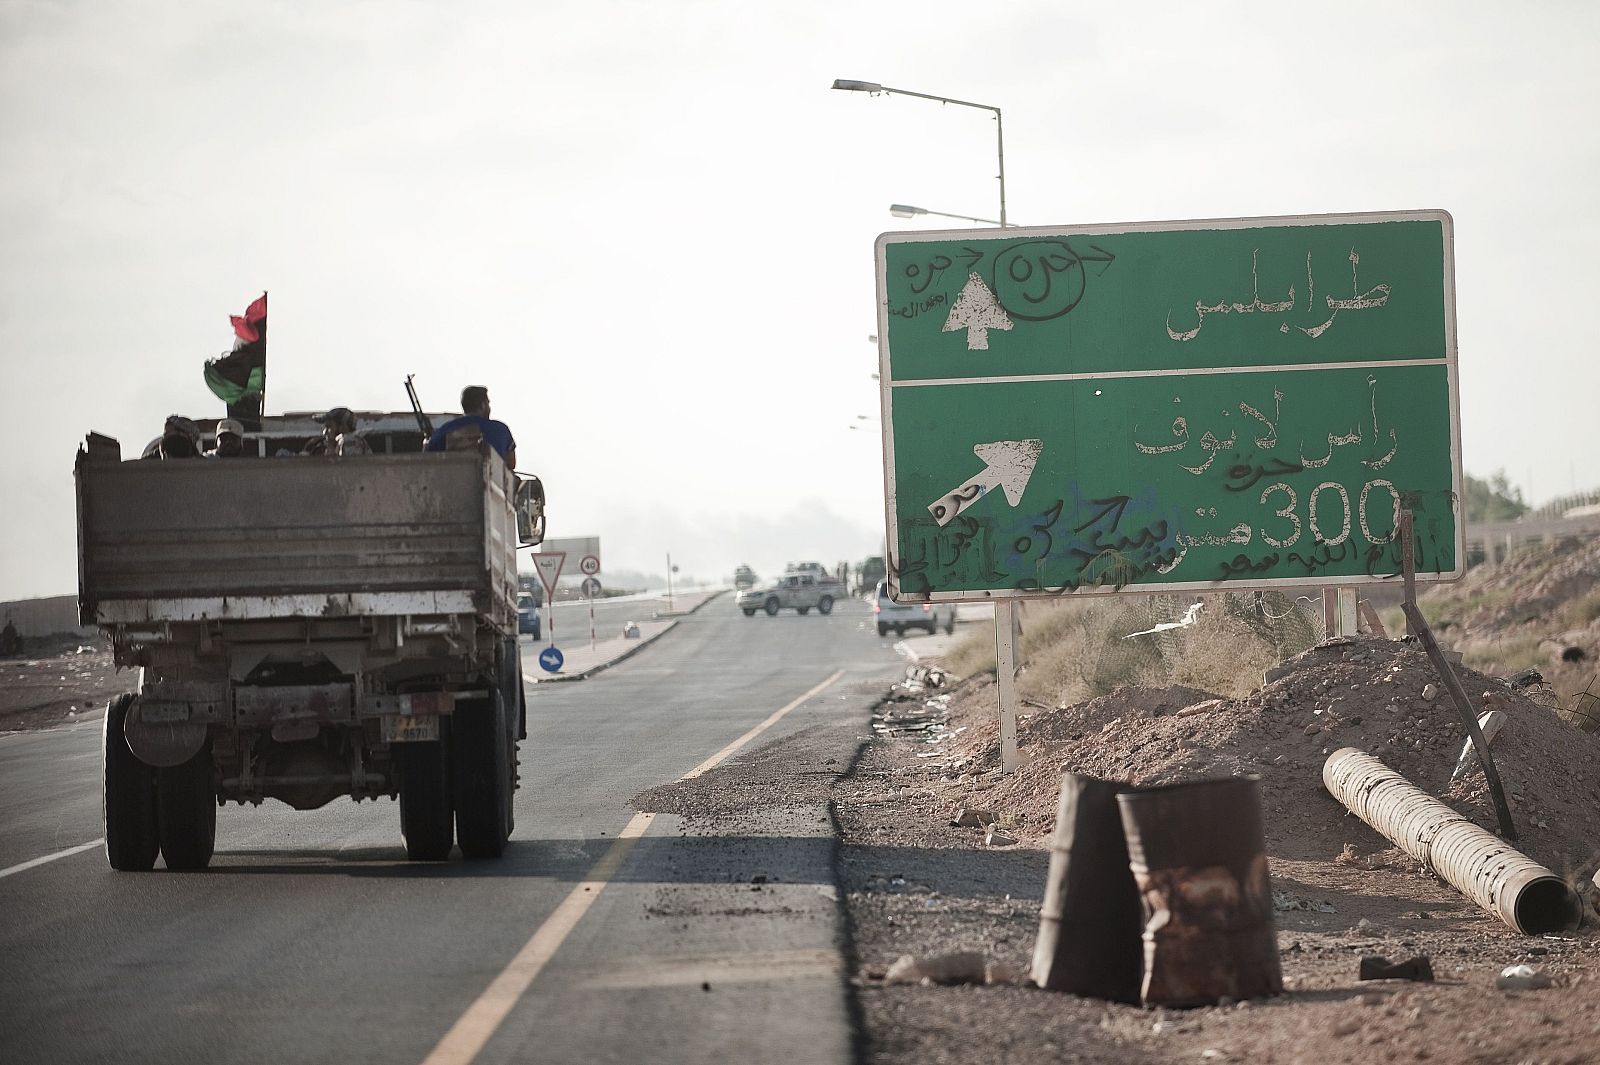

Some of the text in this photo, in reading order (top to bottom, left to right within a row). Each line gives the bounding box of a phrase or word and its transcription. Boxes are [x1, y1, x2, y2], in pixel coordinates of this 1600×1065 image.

[1166, 246, 1392, 341] طرابلس
[1152, 506, 1252, 574] متر
[1260, 479, 1401, 547] 300
[584, 560, 596, 570] 40
